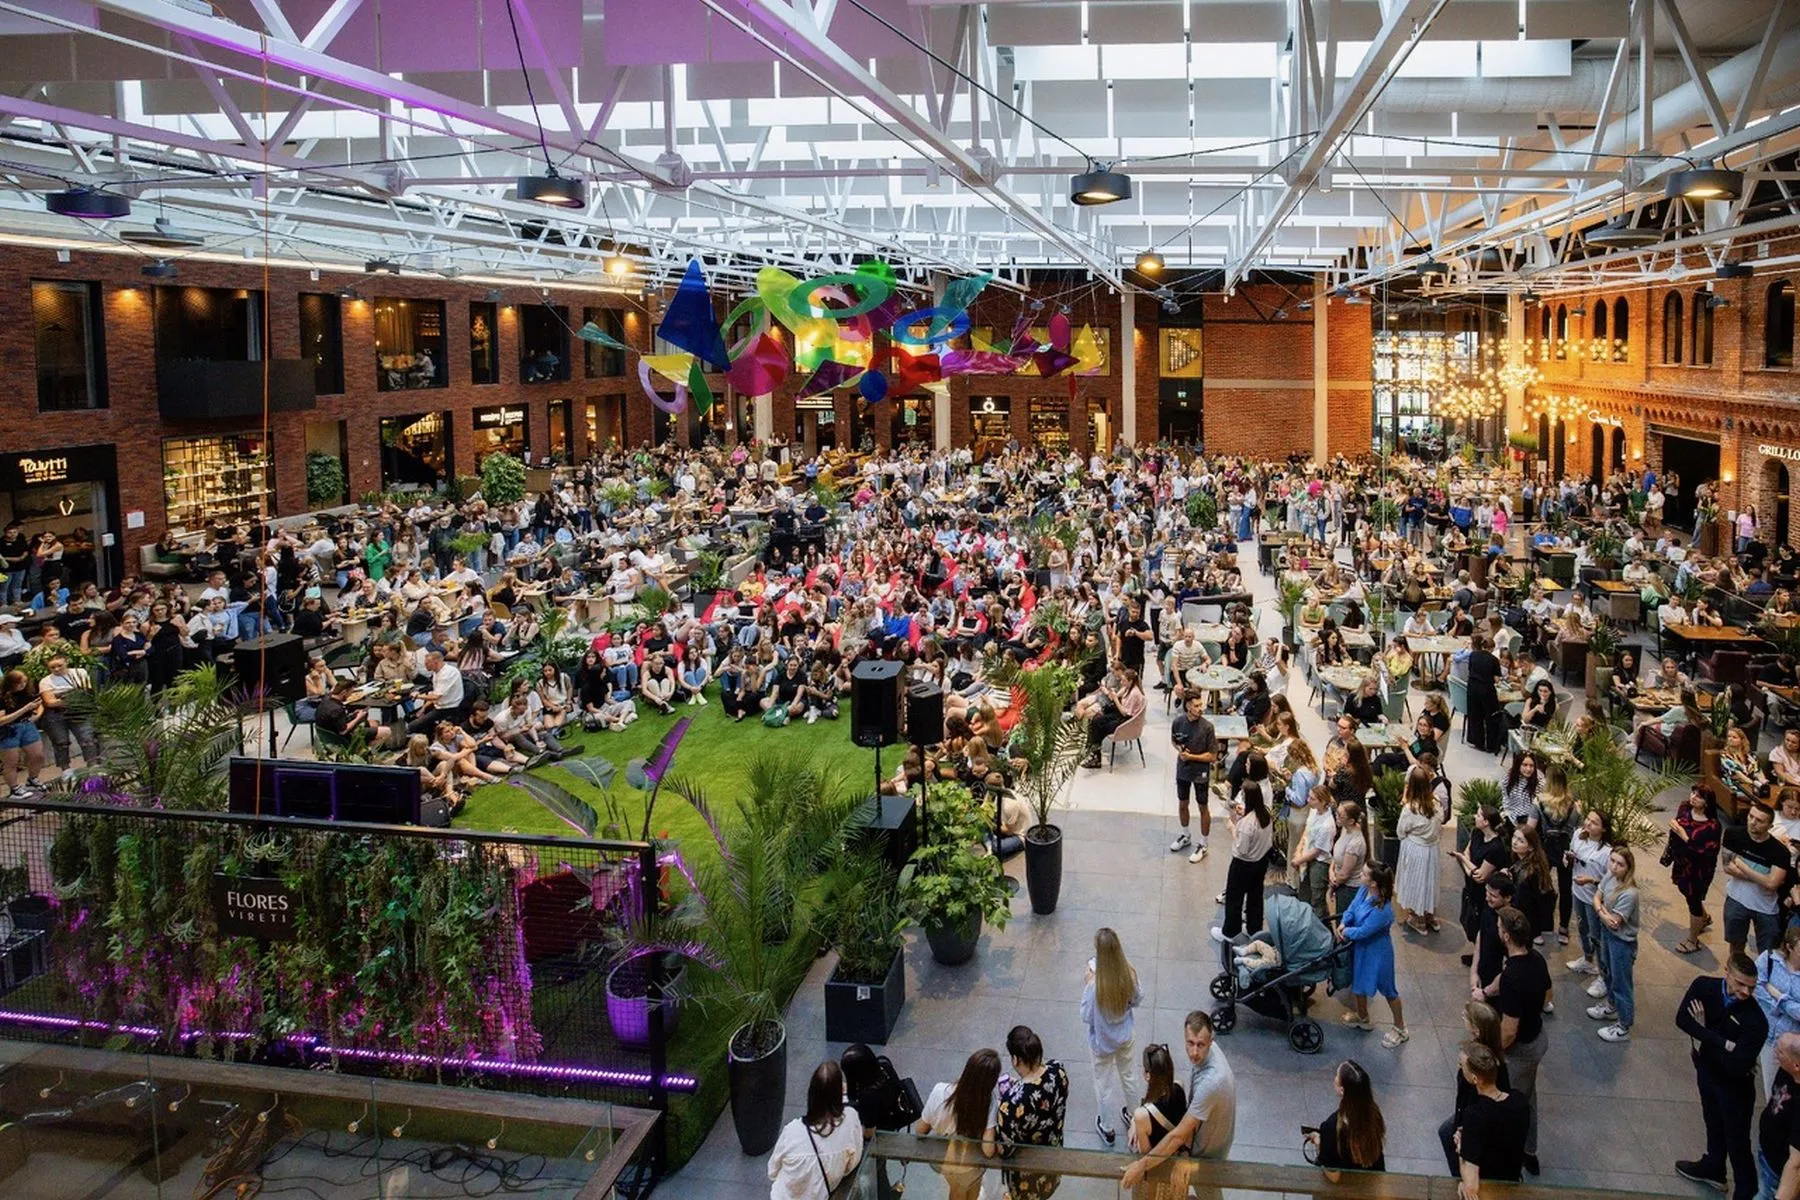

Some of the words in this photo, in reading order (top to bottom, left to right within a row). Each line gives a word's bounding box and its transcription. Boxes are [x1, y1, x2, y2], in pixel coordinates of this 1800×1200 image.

[1758, 444, 1787, 458] GRILL
[227, 891, 289, 911] FLORES
[229, 909, 286, 923] VIRETI
